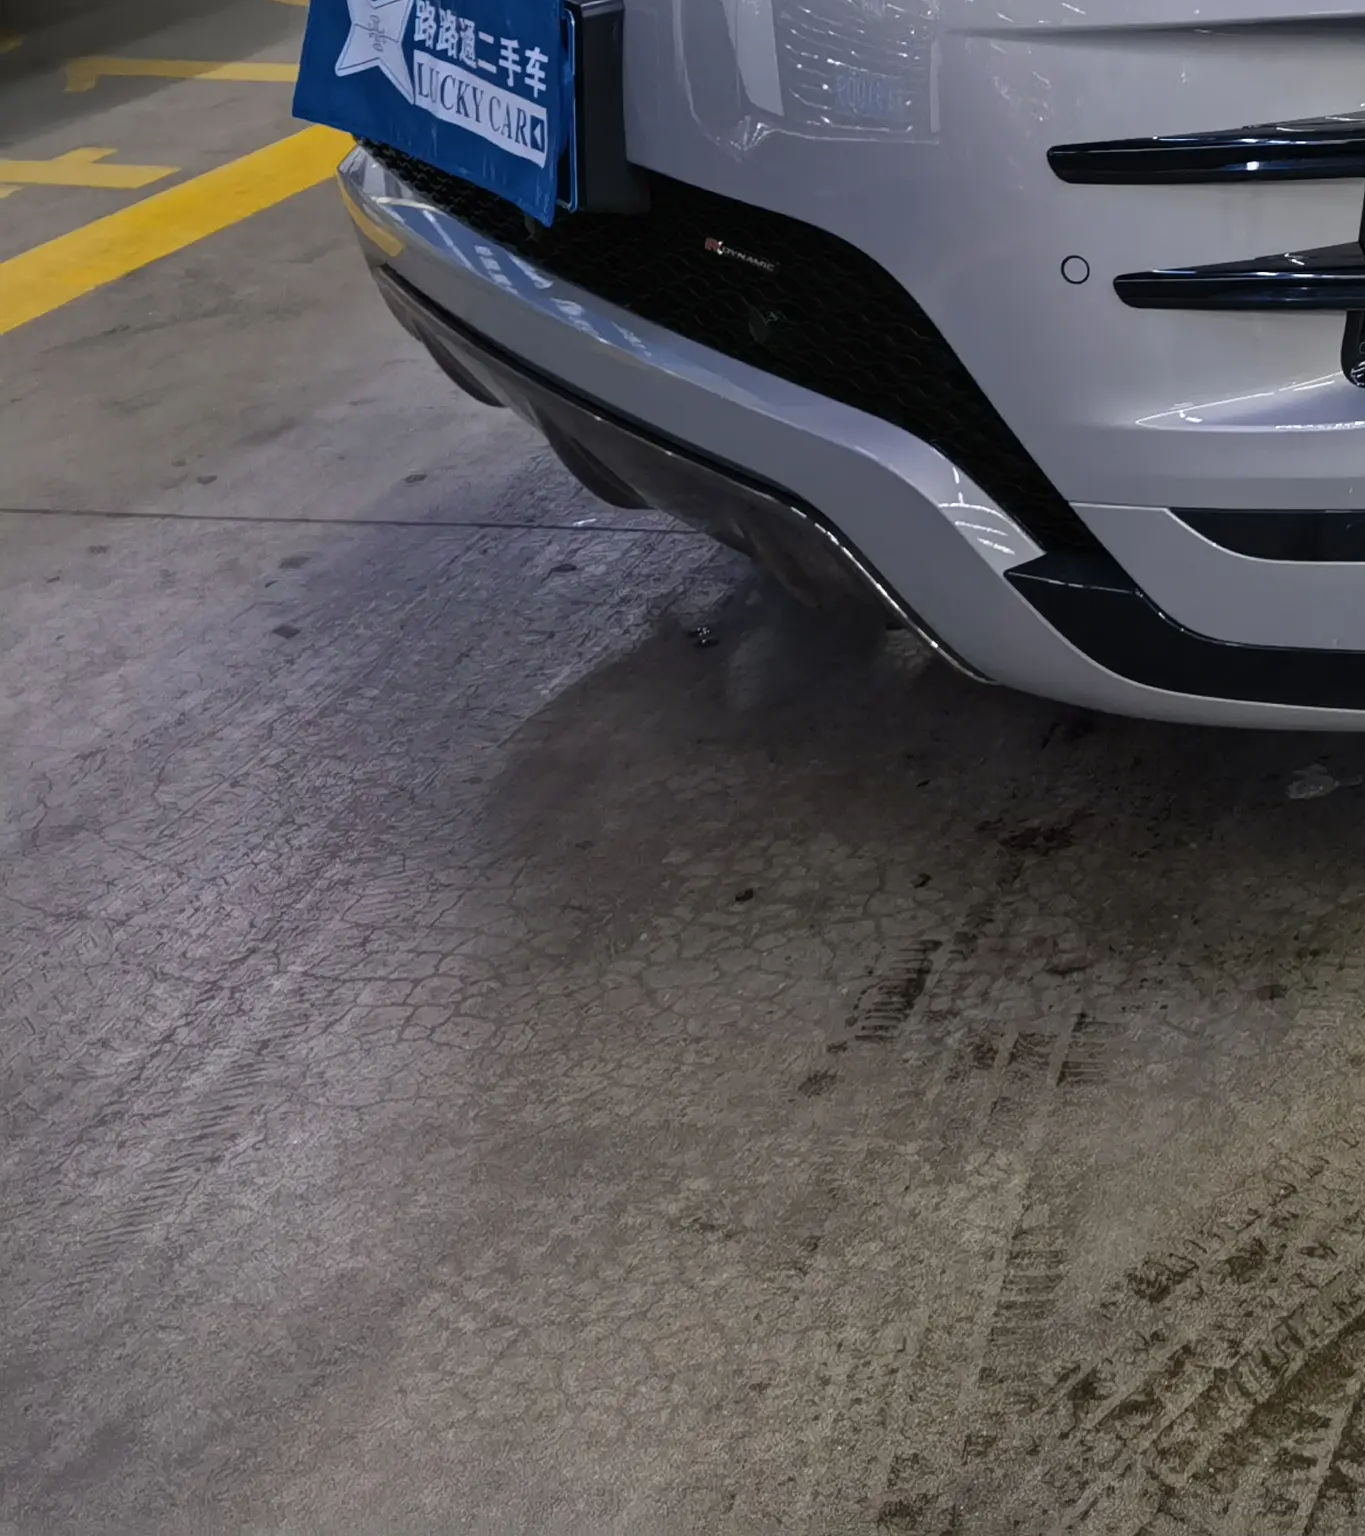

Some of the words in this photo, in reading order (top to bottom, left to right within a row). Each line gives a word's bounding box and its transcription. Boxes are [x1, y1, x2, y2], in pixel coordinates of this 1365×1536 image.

[413, 0, 549, 99] 路路通二手车
[416, 62, 485, 124] LUCKY
[489, 95, 529, 148] CAR
